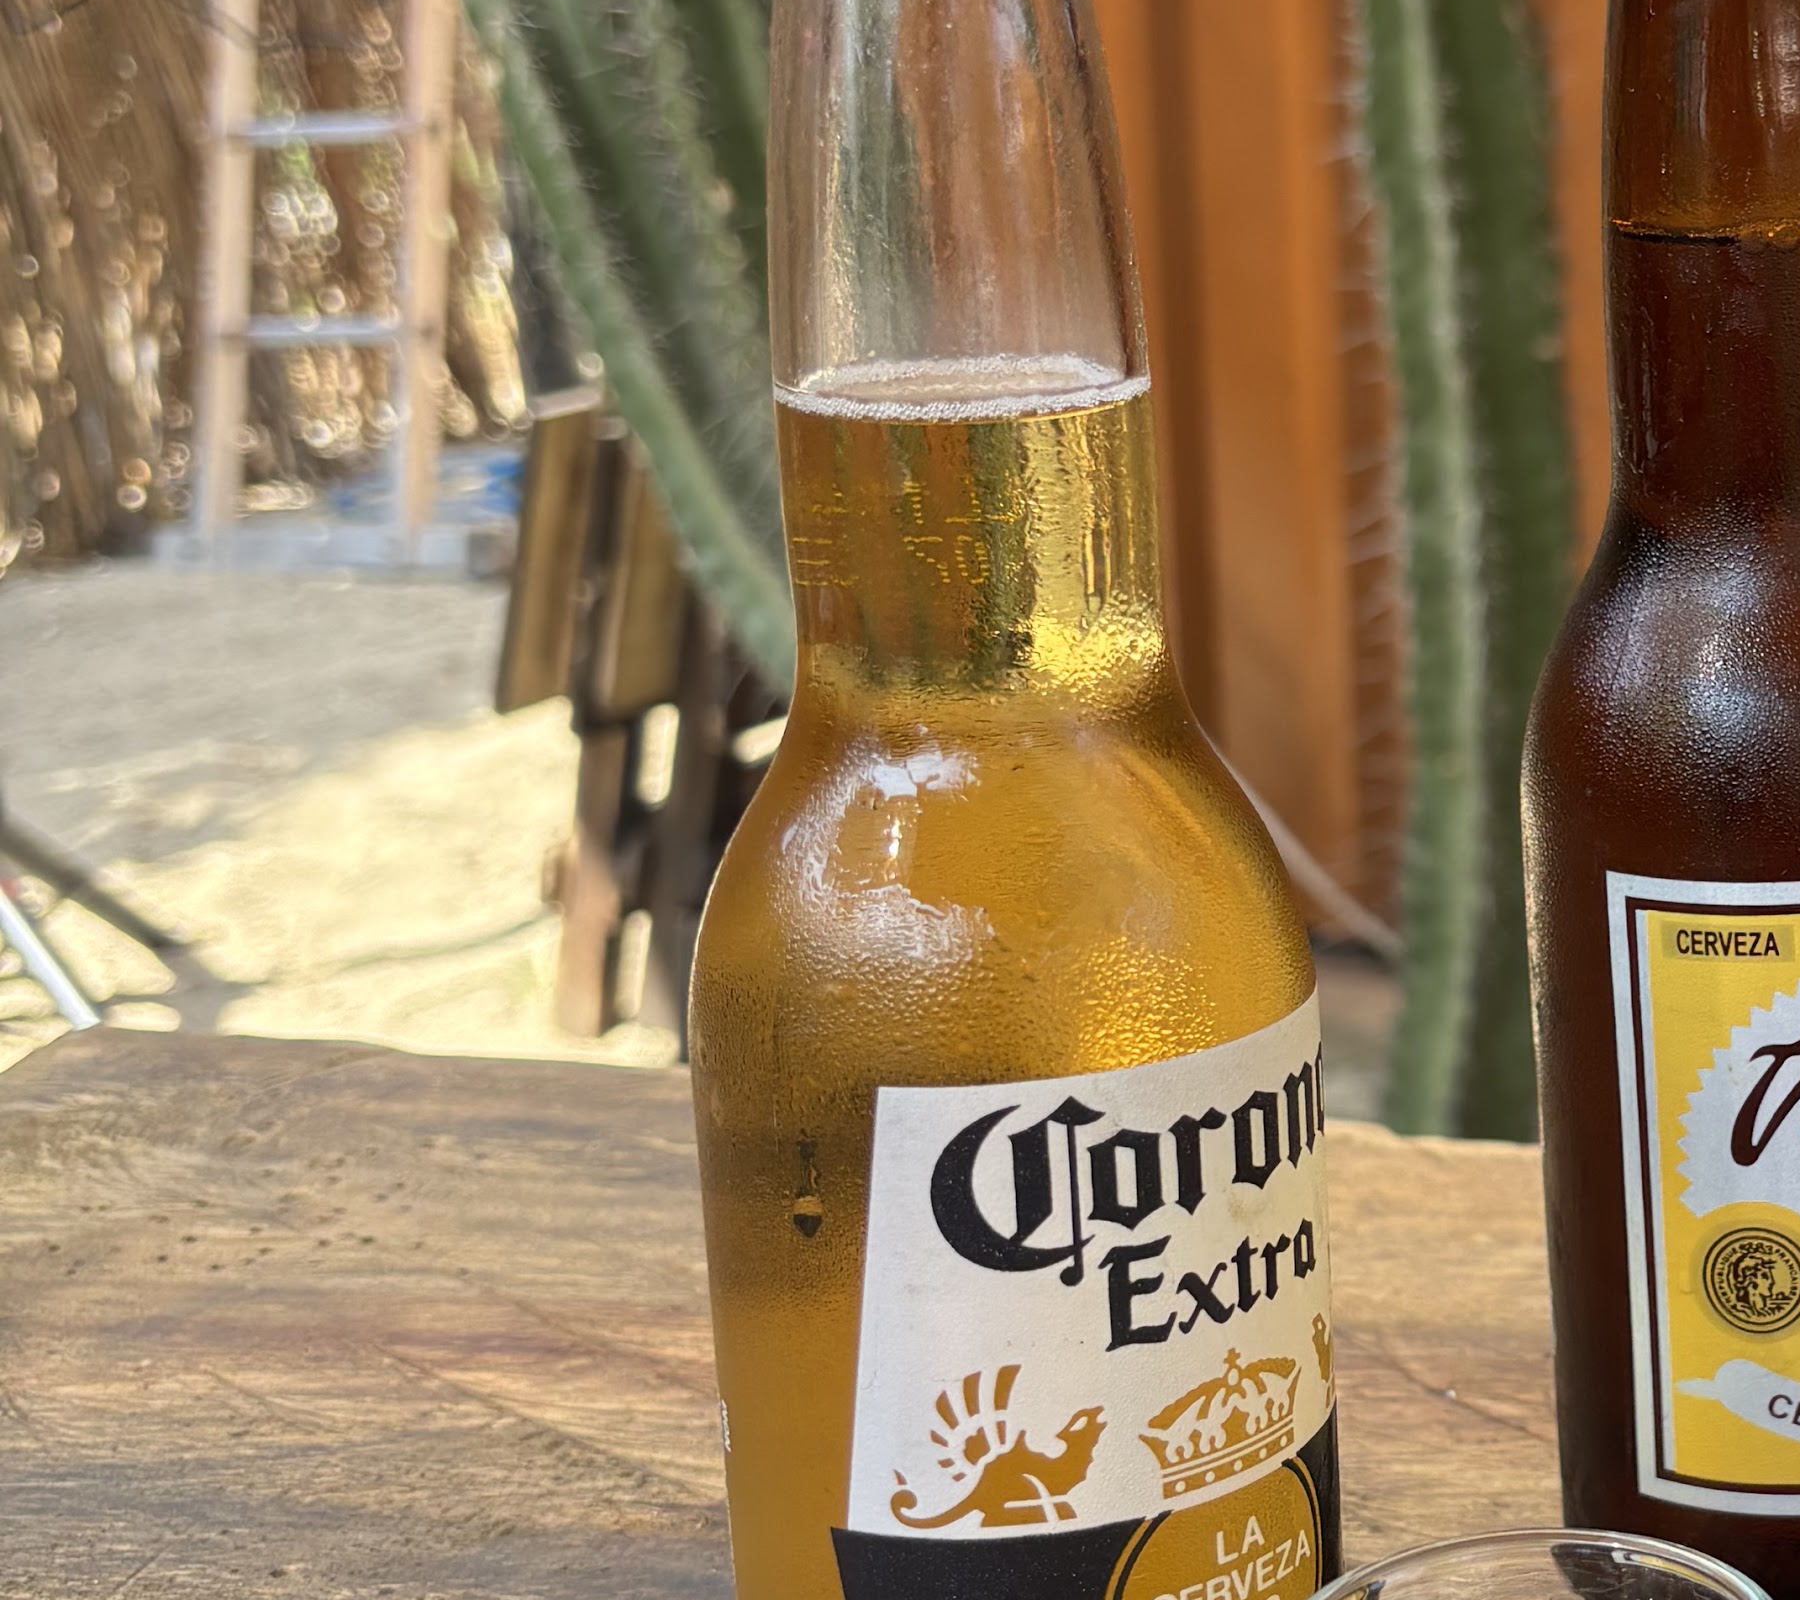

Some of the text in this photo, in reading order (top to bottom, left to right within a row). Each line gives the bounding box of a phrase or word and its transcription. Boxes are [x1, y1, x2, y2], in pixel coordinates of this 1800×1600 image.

[1676, 929, 1780, 957] CERVEZA
[1098, 1217, 1317, 1353] Extra
[1216, 1515, 1266, 1566] LA
